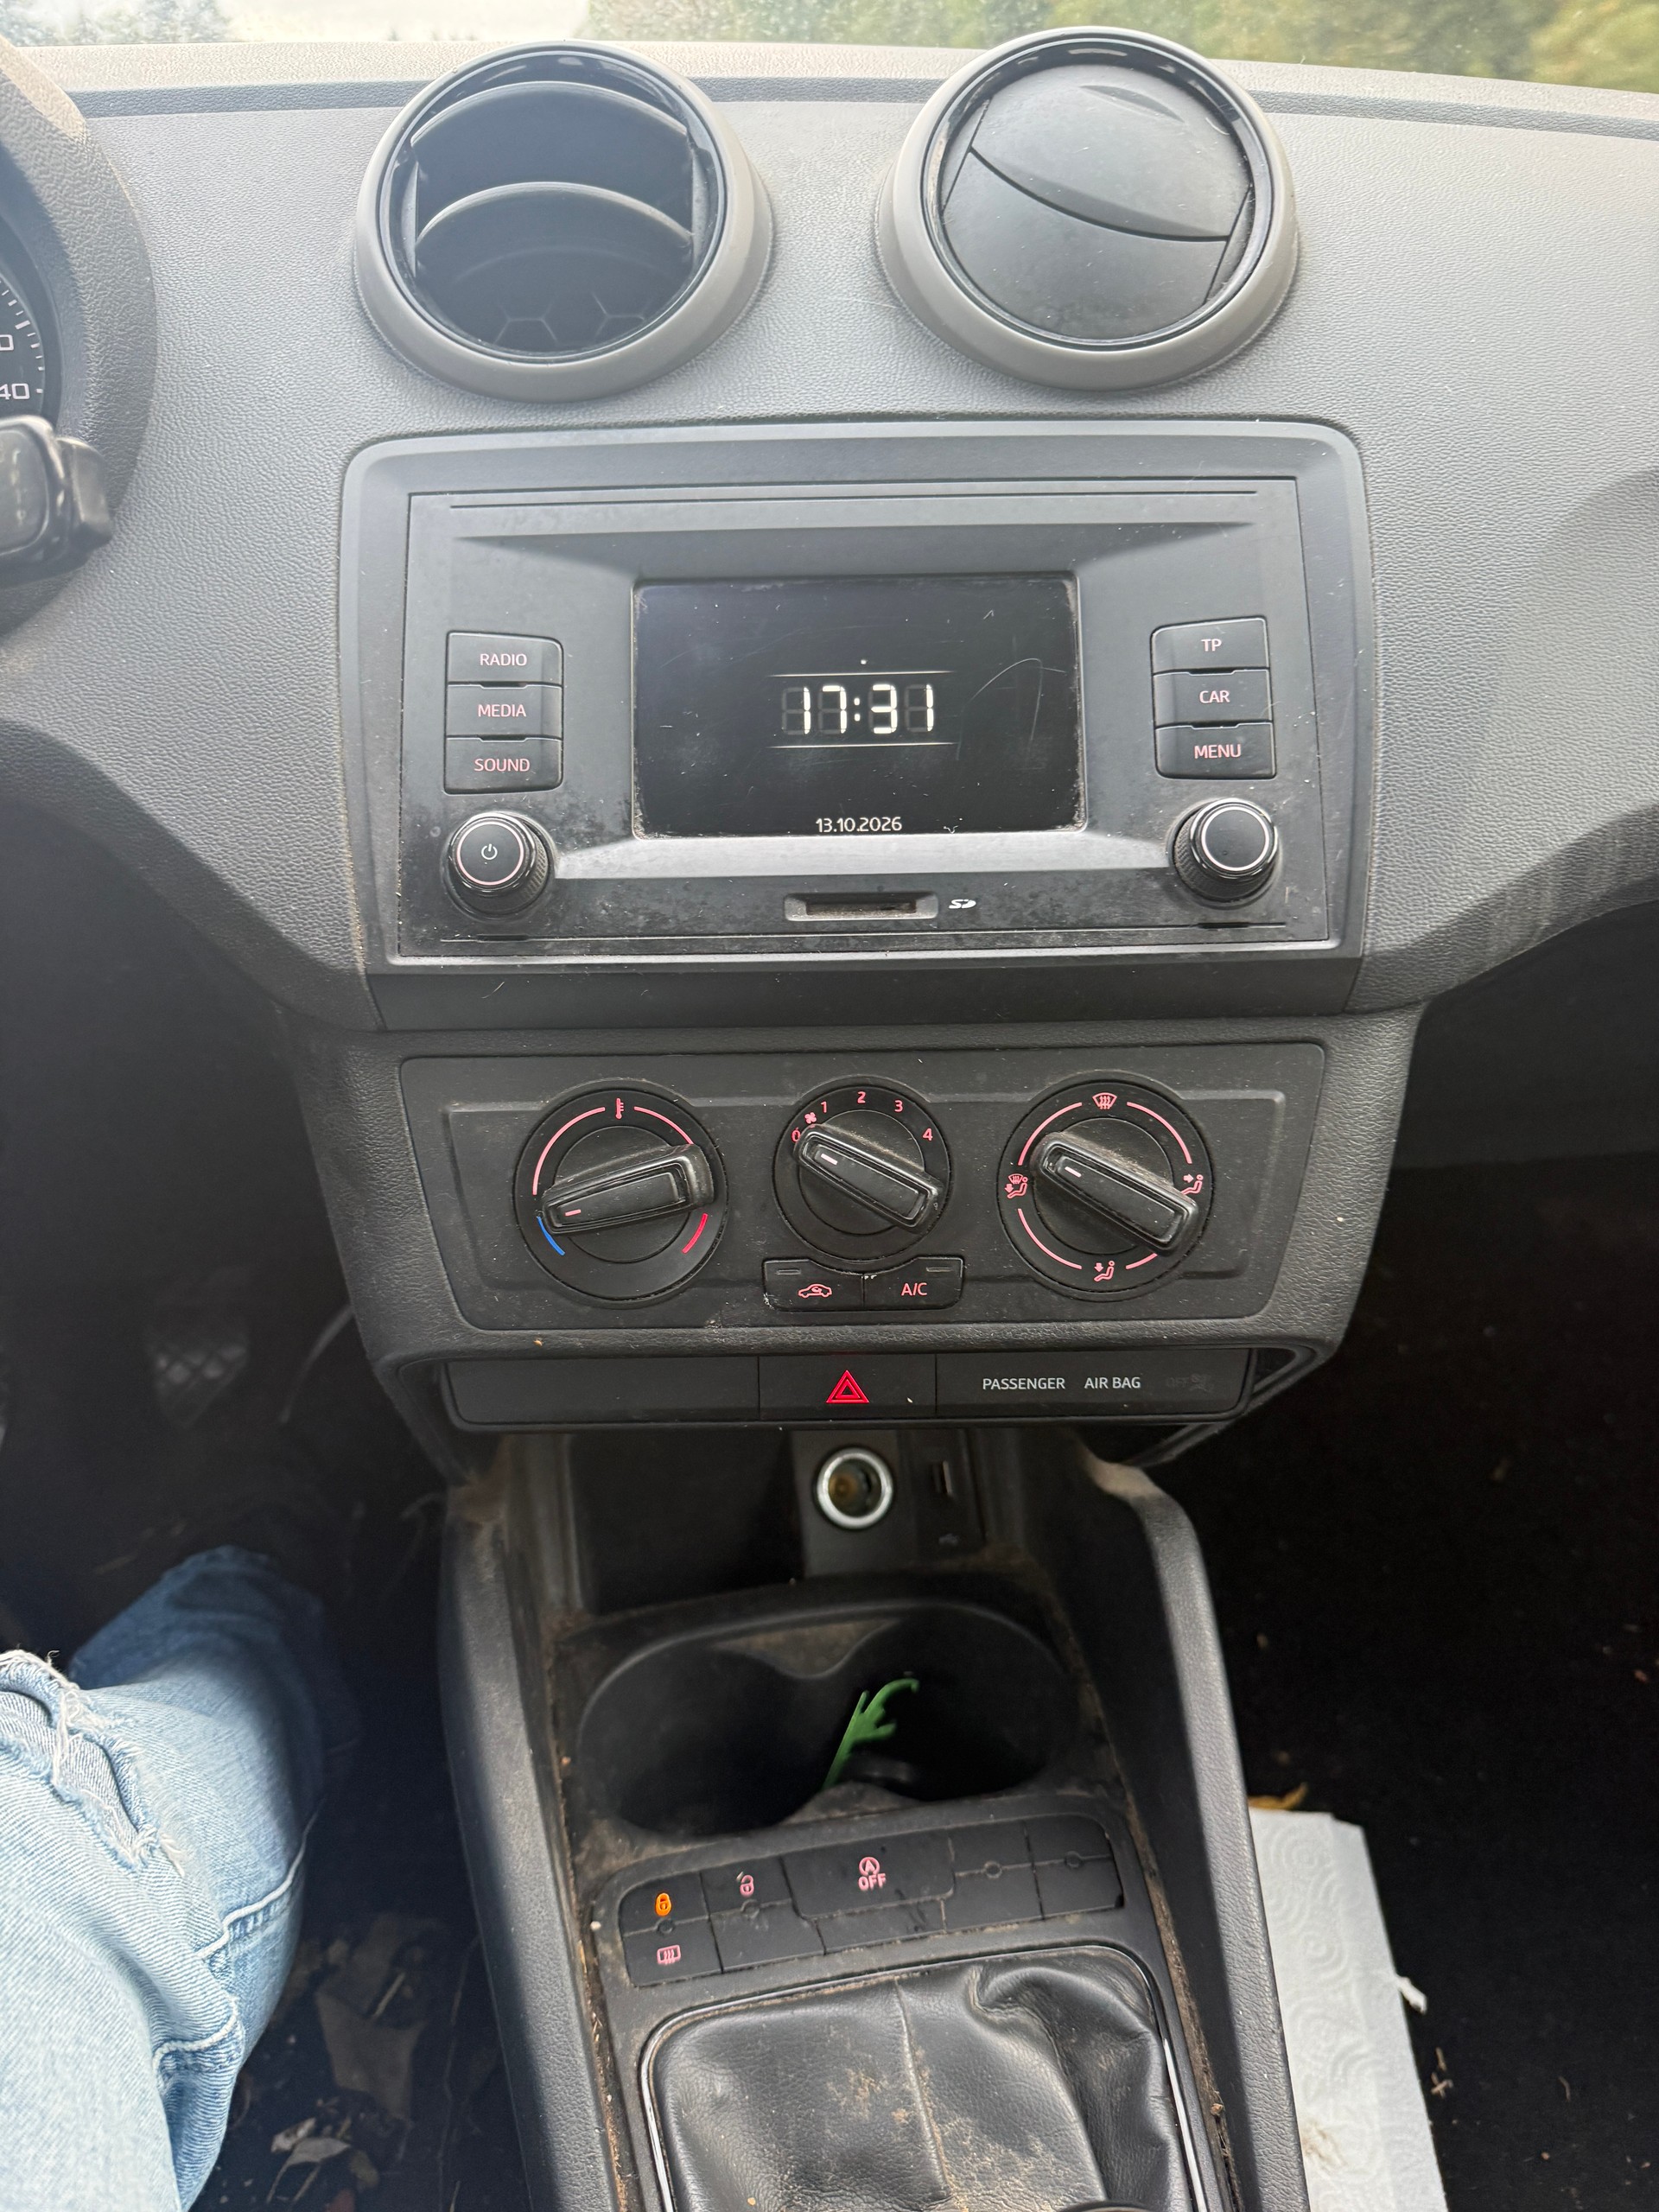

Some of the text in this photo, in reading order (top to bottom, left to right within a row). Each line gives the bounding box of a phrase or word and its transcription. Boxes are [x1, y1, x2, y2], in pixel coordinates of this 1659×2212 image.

[0, 383, 30, 400] 40
[1200, 638, 1223, 652] TP
[480, 653, 528, 666] RADIO
[1199, 690, 1230, 704] CAR
[478, 703, 527, 717] MEDIA
[802, 683, 935, 734] 17:31
[1194, 743, 1243, 760] MENU
[474, 758, 531, 772] SOUND
[816, 817, 903, 833] 13.10.2026
[857, 1090, 867, 1104] 2
[821, 1101, 827, 1114] 1
[894, 1099, 904, 1113] 3
[922, 1128, 933, 1141] 4
[900, 1282, 928, 1297] A/C
[982, 1376, 1066, 1391] PASSENGER
[1084, 1376, 1109, 1389] AIR
[1112, 1376, 1141, 1389] BAG
[858, 1872, 887, 1891] OFF
